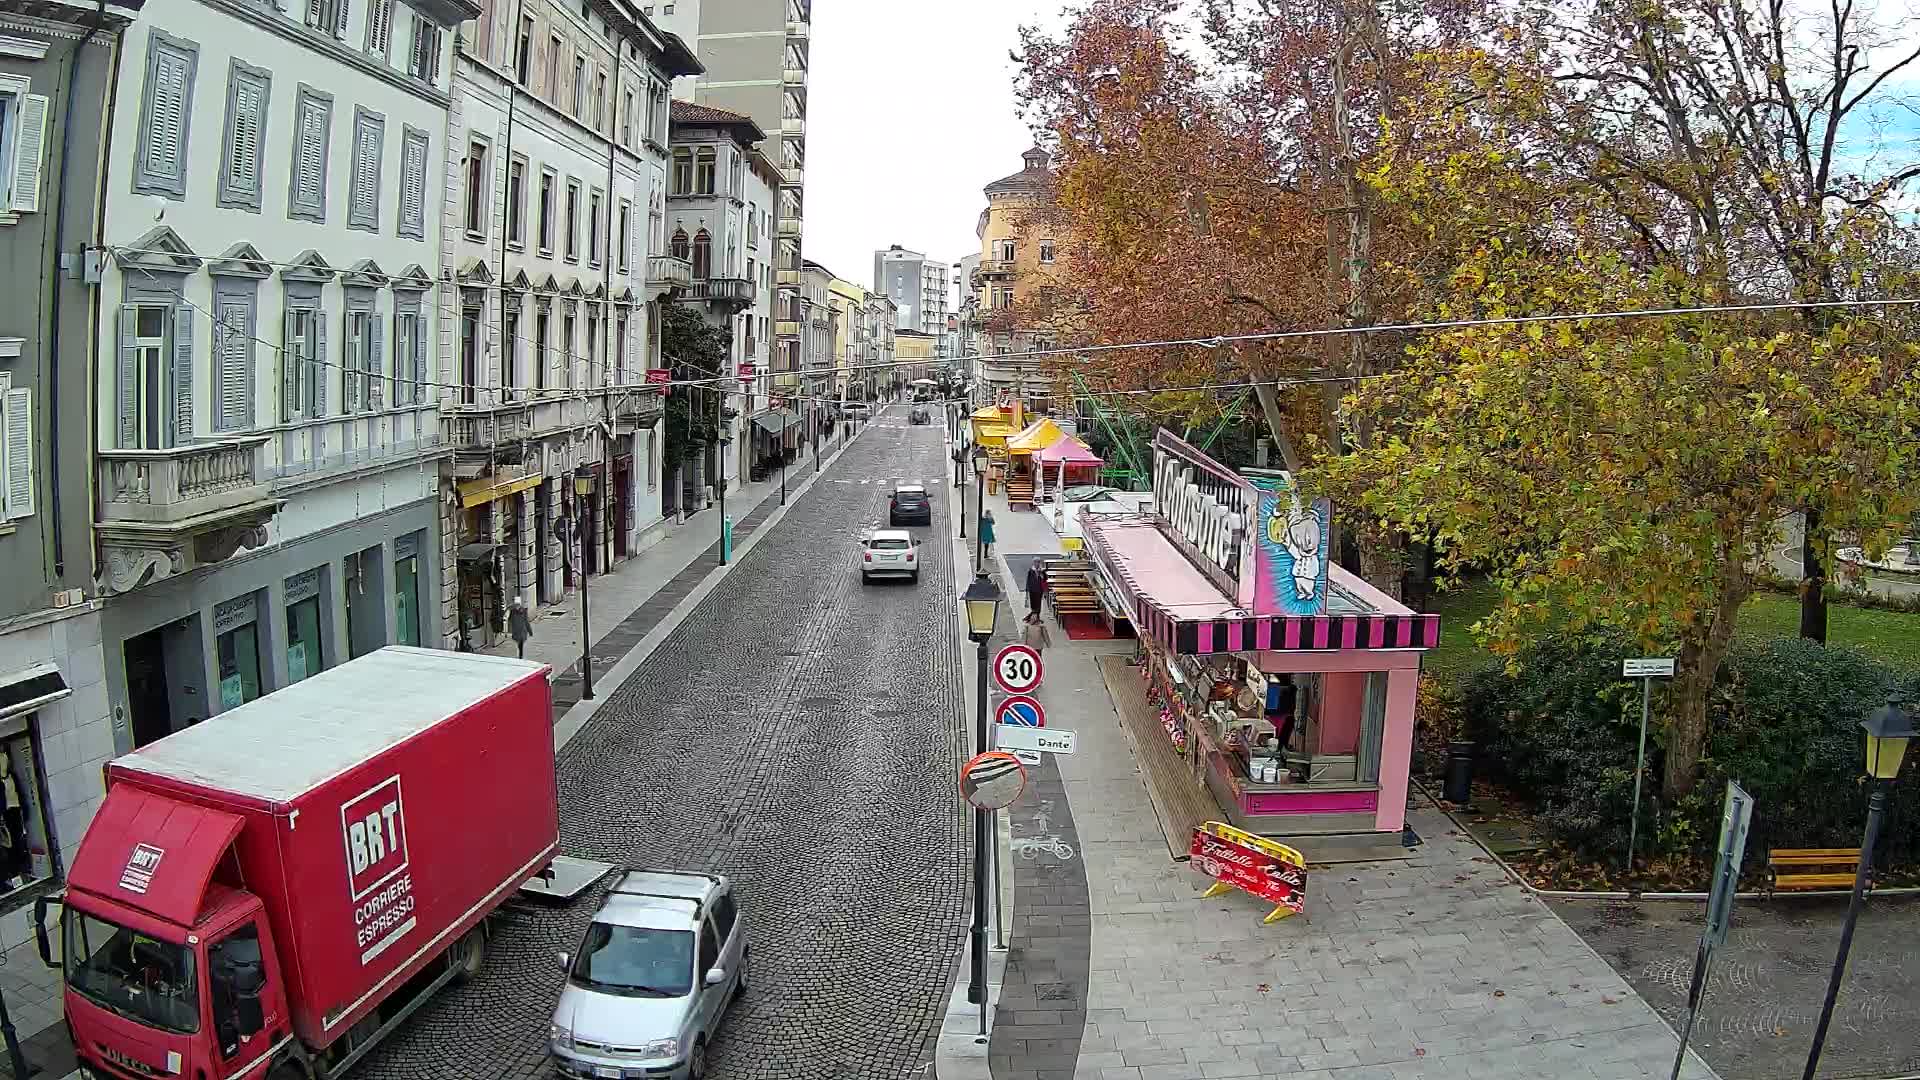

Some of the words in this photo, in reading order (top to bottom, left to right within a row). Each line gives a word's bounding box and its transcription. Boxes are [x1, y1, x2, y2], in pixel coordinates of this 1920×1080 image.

[1005, 658, 1033, 681] 30
[1038, 738, 1070, 749] Dante
[350, 801, 398, 876] BRT
[132, 848, 160, 869] BRT
[355, 873, 413, 925] CORRIERE
[357, 895, 415, 948] ESPRESSO
